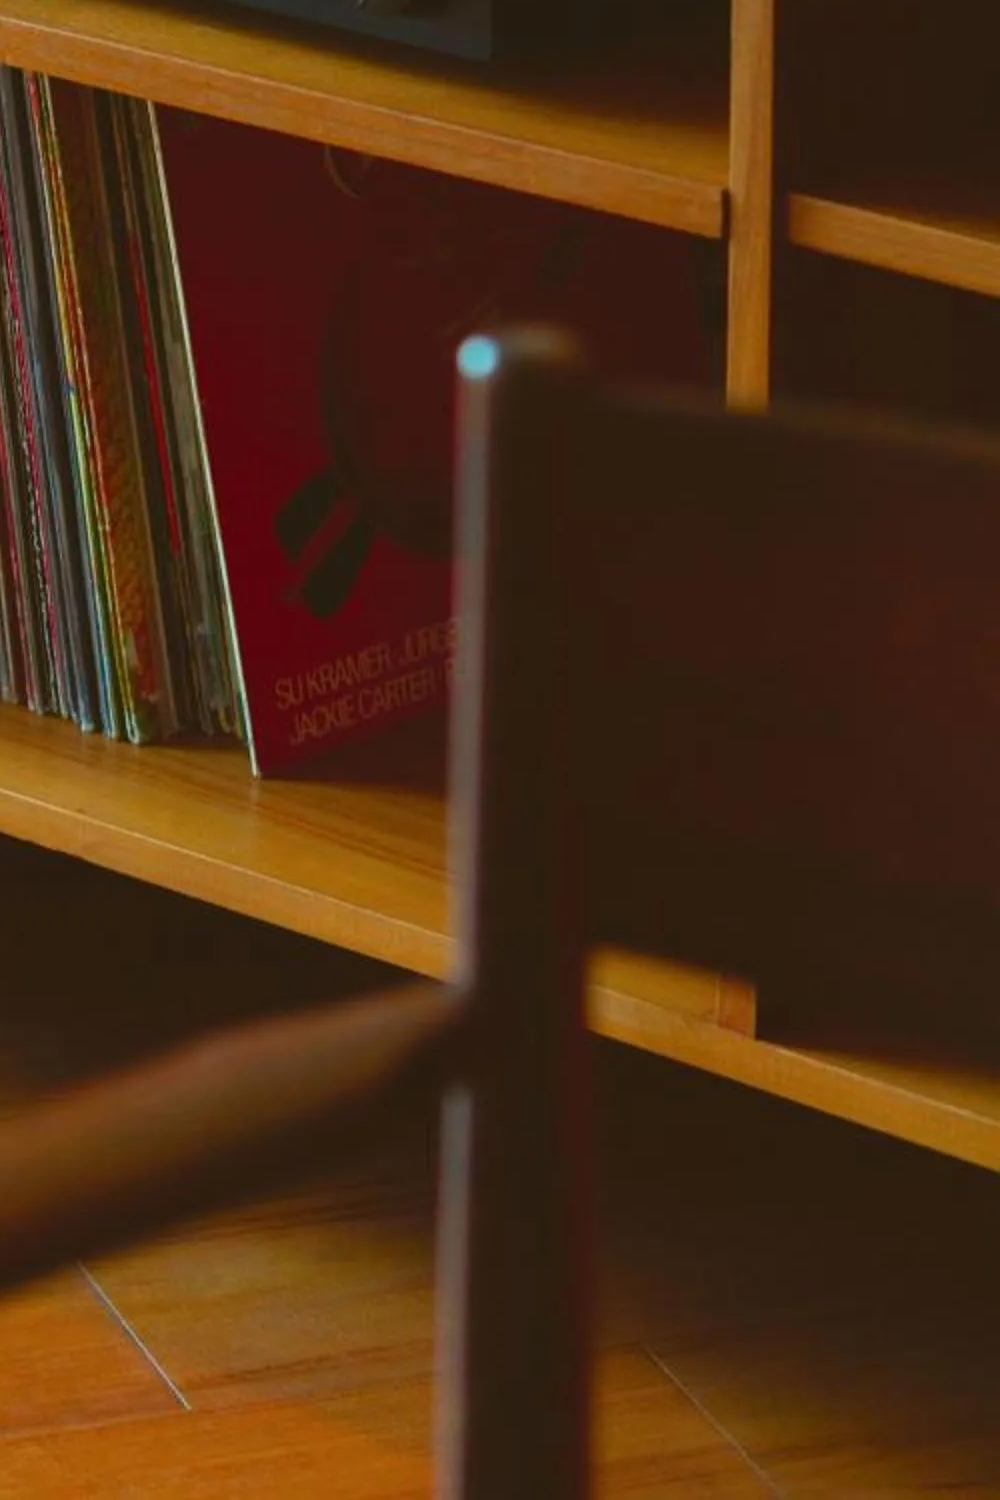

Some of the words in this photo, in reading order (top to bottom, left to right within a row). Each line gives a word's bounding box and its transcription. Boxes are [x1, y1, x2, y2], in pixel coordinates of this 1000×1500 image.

[274, 676, 304, 711] SU
[305, 641, 394, 700] KRAMER
[289, 694, 359, 747] JACKIE
[358, 666, 438, 720] CARTER
